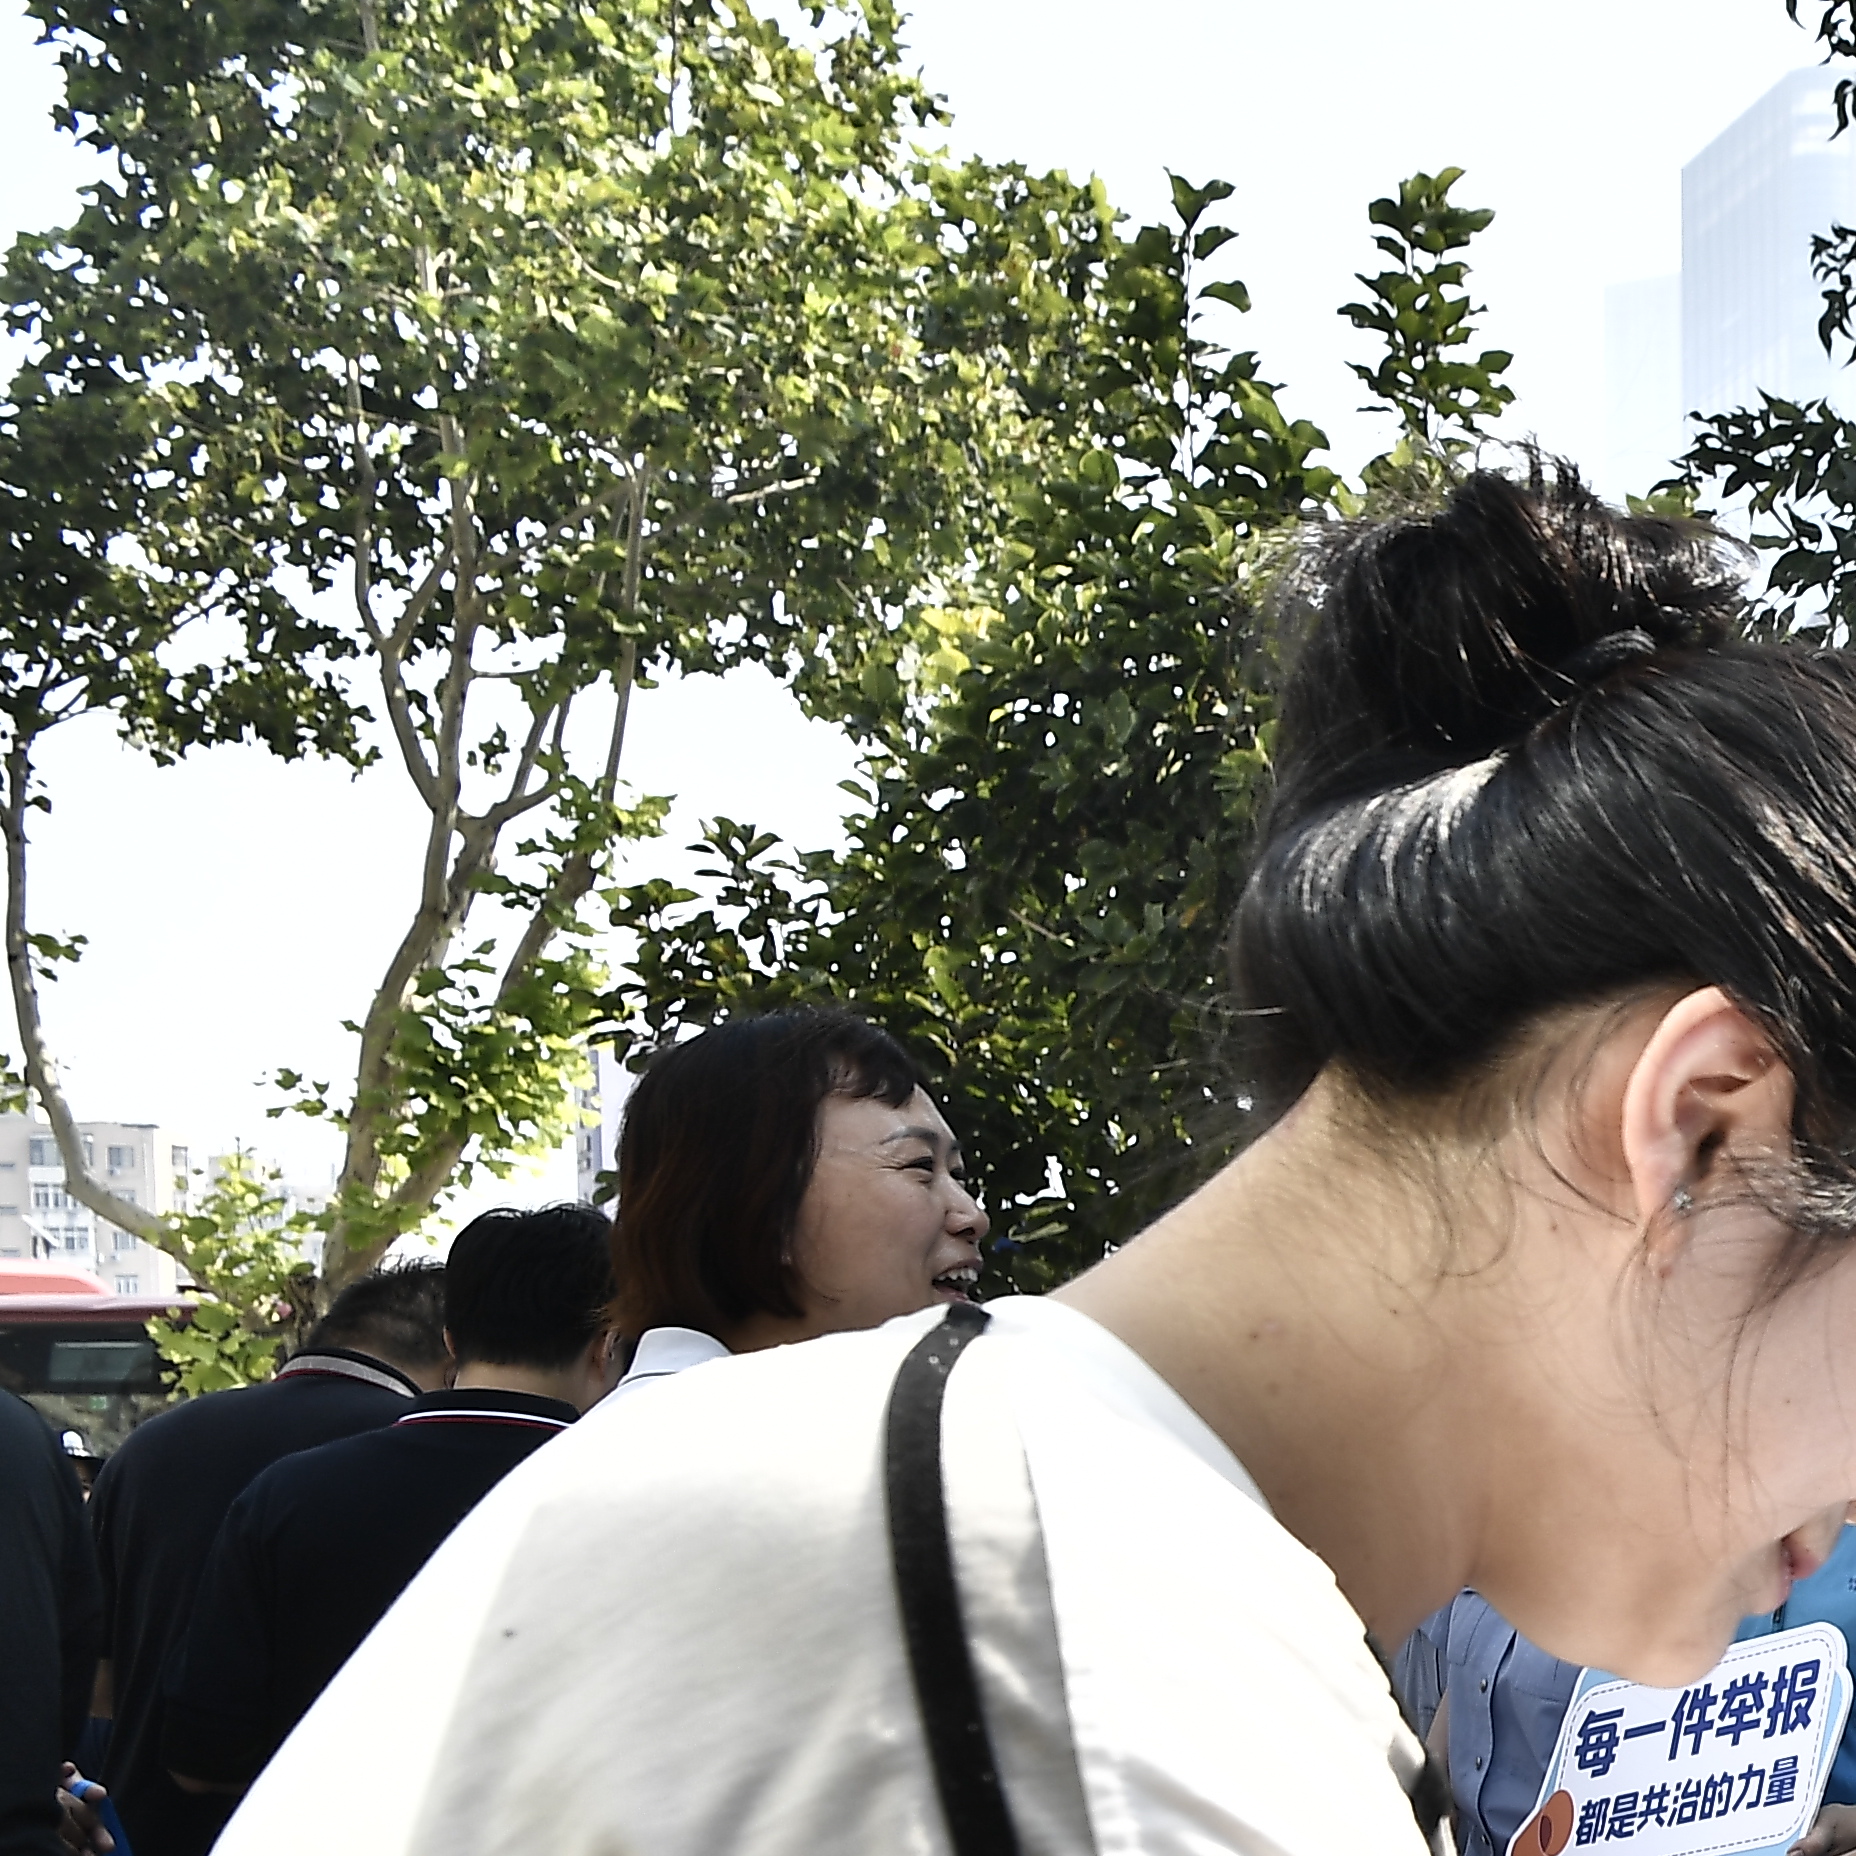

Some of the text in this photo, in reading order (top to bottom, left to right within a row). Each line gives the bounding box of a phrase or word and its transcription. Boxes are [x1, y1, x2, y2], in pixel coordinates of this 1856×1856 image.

[1575, 1659, 1821, 1778] 每一件举报
[1575, 1755, 1800, 1847] 都是共治的力量
